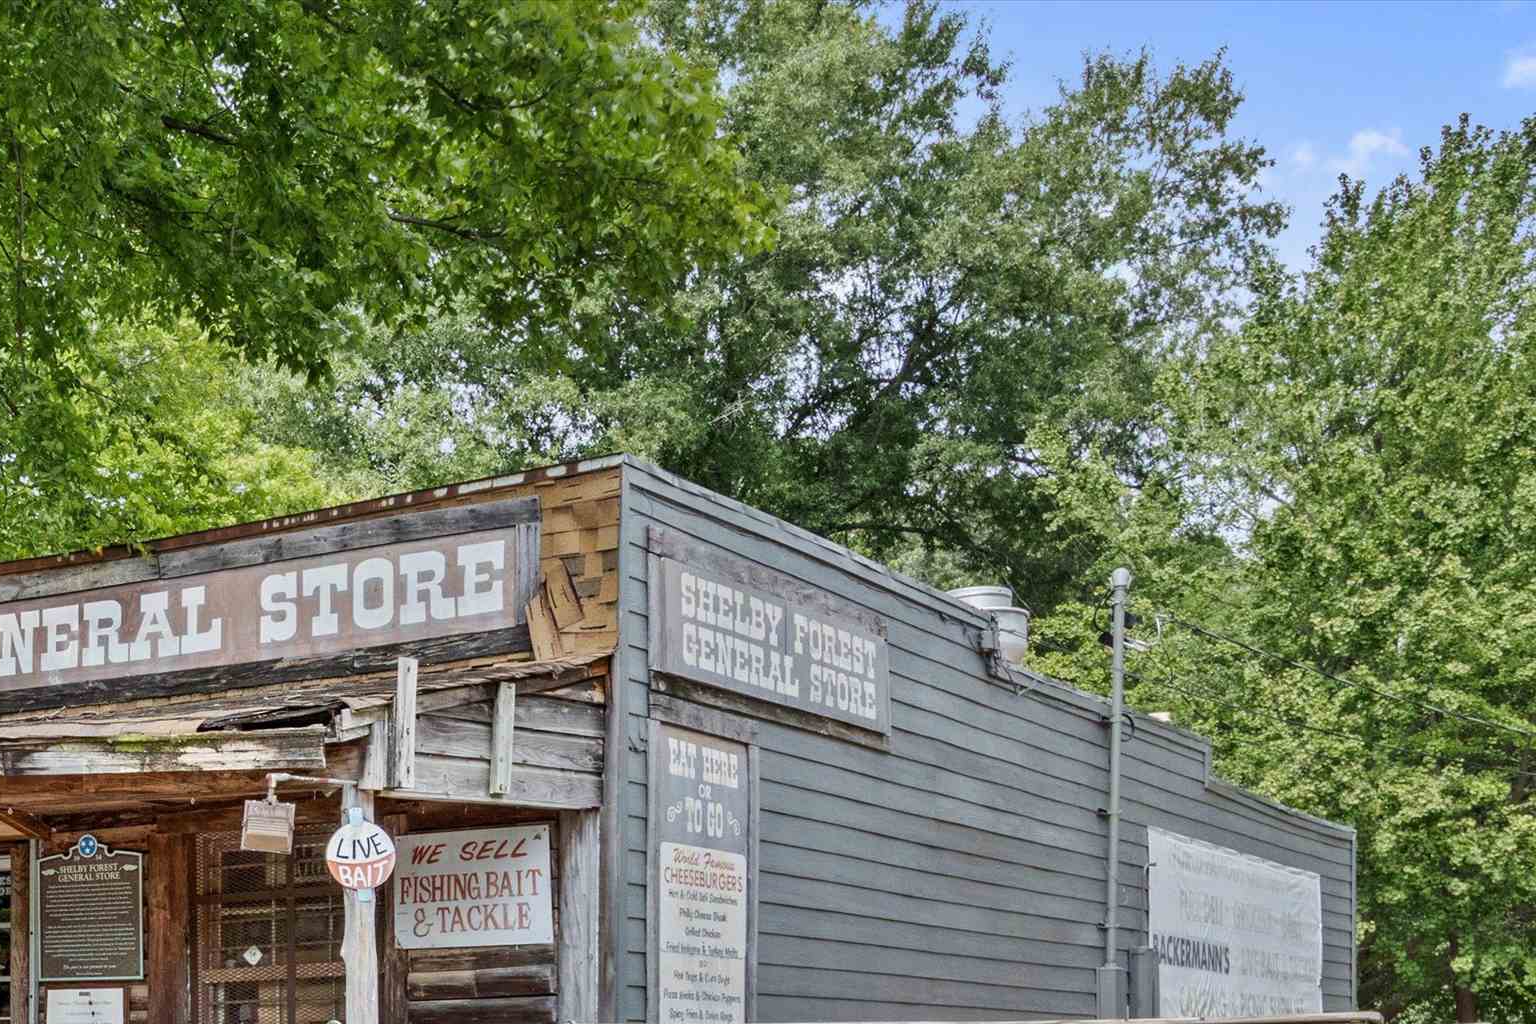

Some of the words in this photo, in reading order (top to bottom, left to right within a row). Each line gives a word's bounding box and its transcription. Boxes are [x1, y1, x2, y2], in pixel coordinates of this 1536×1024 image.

[260, 540, 506, 643] STORE
[681, 572, 783, 647] SHELBY
[794, 614, 877, 680] FOREST
[682, 622, 799, 697] GENERAL
[810, 664, 877, 720] STORE
[668, 737, 696, 779] EAT
[702, 746, 738, 788] HERE
[698, 784, 711, 800] OR
[685, 797, 702, 832] TO
[707, 802, 723, 838] GO
[337, 833, 387, 860] LIVE
[411, 844, 448, 865] WE
[459, 838, 528, 862] SELL
[58, 873, 94, 882] GENERAL
[95, 872, 120, 881] STORE
[60, 864, 87, 874] SHELBY
[89, 863, 119, 872] FOREST
[337, 860, 390, 888] BAIT
[664, 866, 743, 893] CHEESEBURGERS
[399, 871, 482, 904] FISHING
[485, 868, 543, 898] BAIT
[413, 908, 434, 937] &
[437, 902, 532, 933] TACKLE
